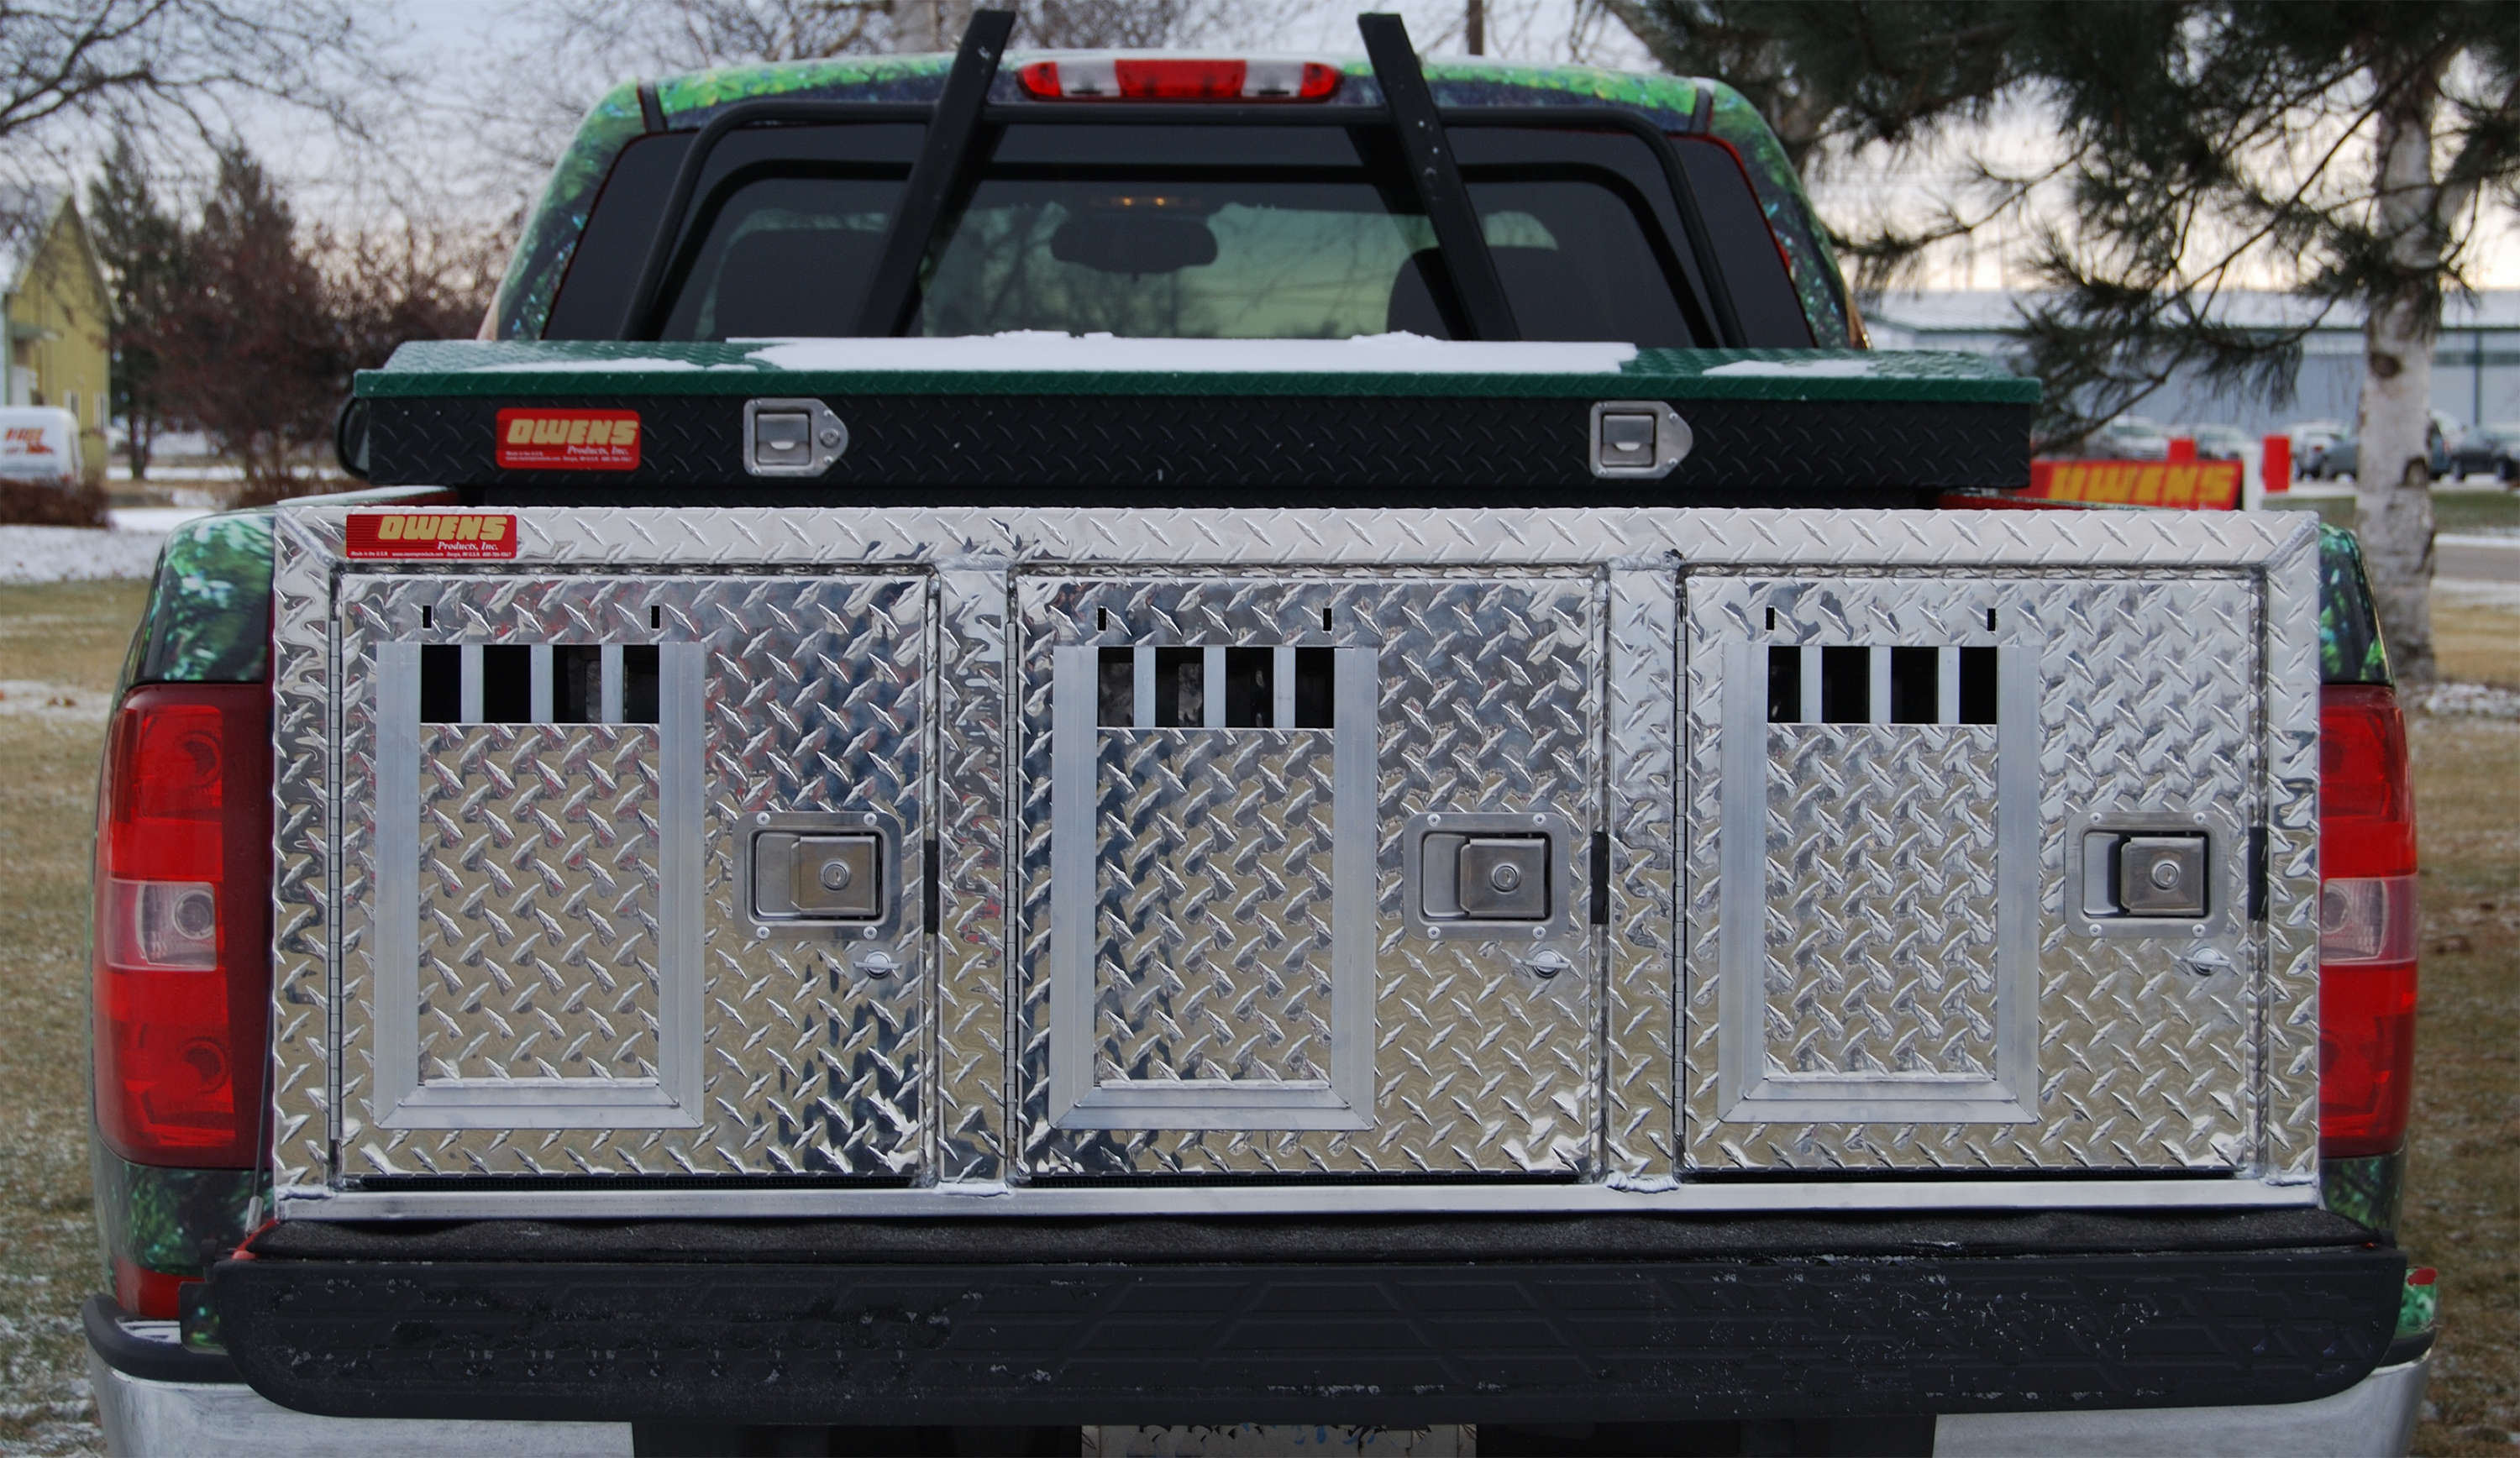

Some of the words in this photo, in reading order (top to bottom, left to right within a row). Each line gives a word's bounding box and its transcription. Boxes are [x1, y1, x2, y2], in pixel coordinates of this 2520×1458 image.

[507, 418, 638, 445] OWENS
[612, 446, 629, 455] Inc.
[2047, 465, 2234, 504] OWENS
[378, 516, 507, 540] OWENS
[437, 541, 478, 551] Products,
[481, 541, 499, 551] Inc.
